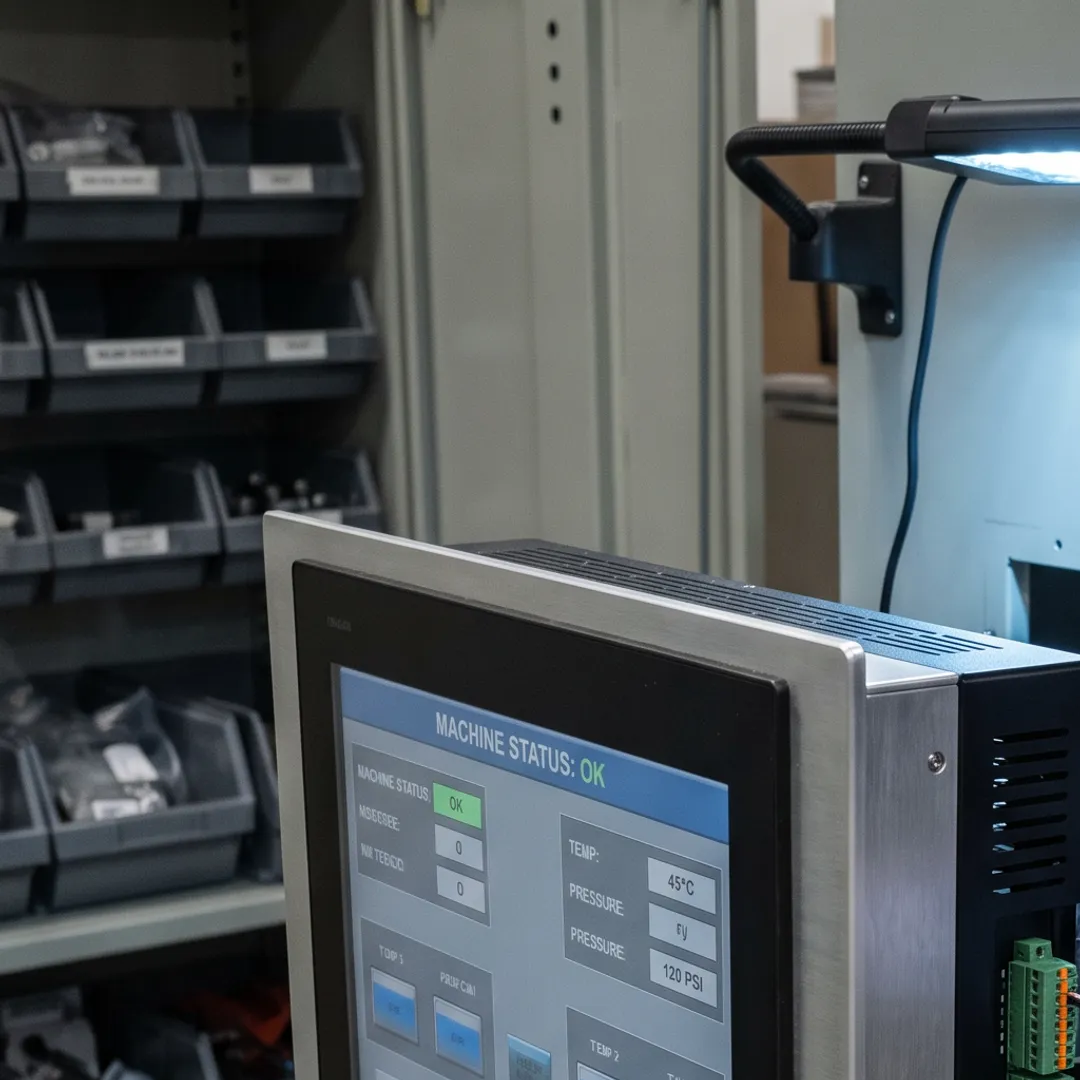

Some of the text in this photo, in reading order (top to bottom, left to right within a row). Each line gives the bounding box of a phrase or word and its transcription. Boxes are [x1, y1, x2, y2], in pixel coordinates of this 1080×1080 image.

[436, 712, 606, 788] MACHINE STATUS: OK
[449, 796, 464, 813] OK
[455, 840, 463, 855] 0
[568, 839, 600, 863] TEMP:
[456, 881, 464, 896] 0
[663, 963, 703, 992] 120 PSI
